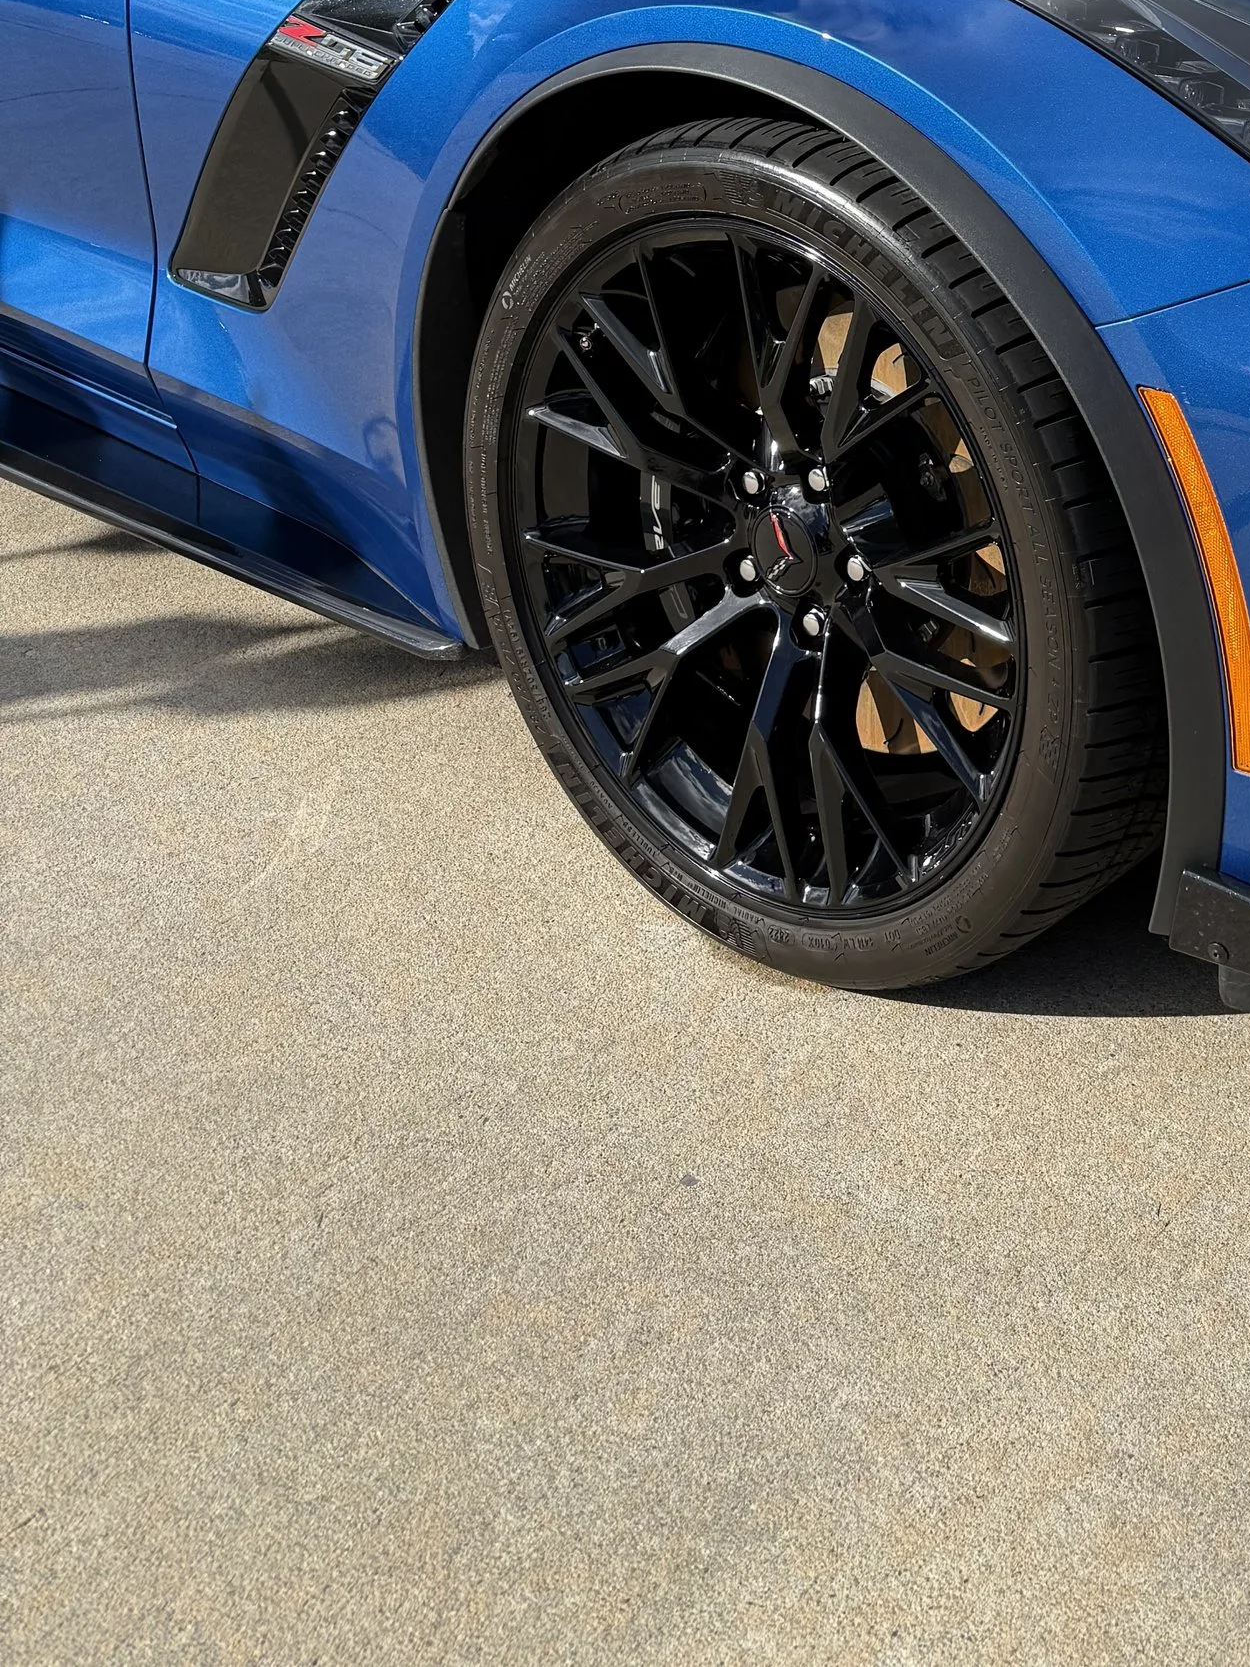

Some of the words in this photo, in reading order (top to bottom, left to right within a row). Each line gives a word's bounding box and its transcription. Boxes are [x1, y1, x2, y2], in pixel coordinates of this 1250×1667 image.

[278, 15, 393, 73] Z06
[508, 254, 532, 291] MICHELIN
[772, 188, 954, 346] MICHELIN
[967, 377, 1005, 433] PILOT
[1000, 442, 1037, 515] SPORT
[1026, 523, 1049, 566] ALL
[1039, 574, 1061, 671] SEASON
[556, 762, 708, 924] MICHELIN
[924, 930, 959, 956] MICHELIN
